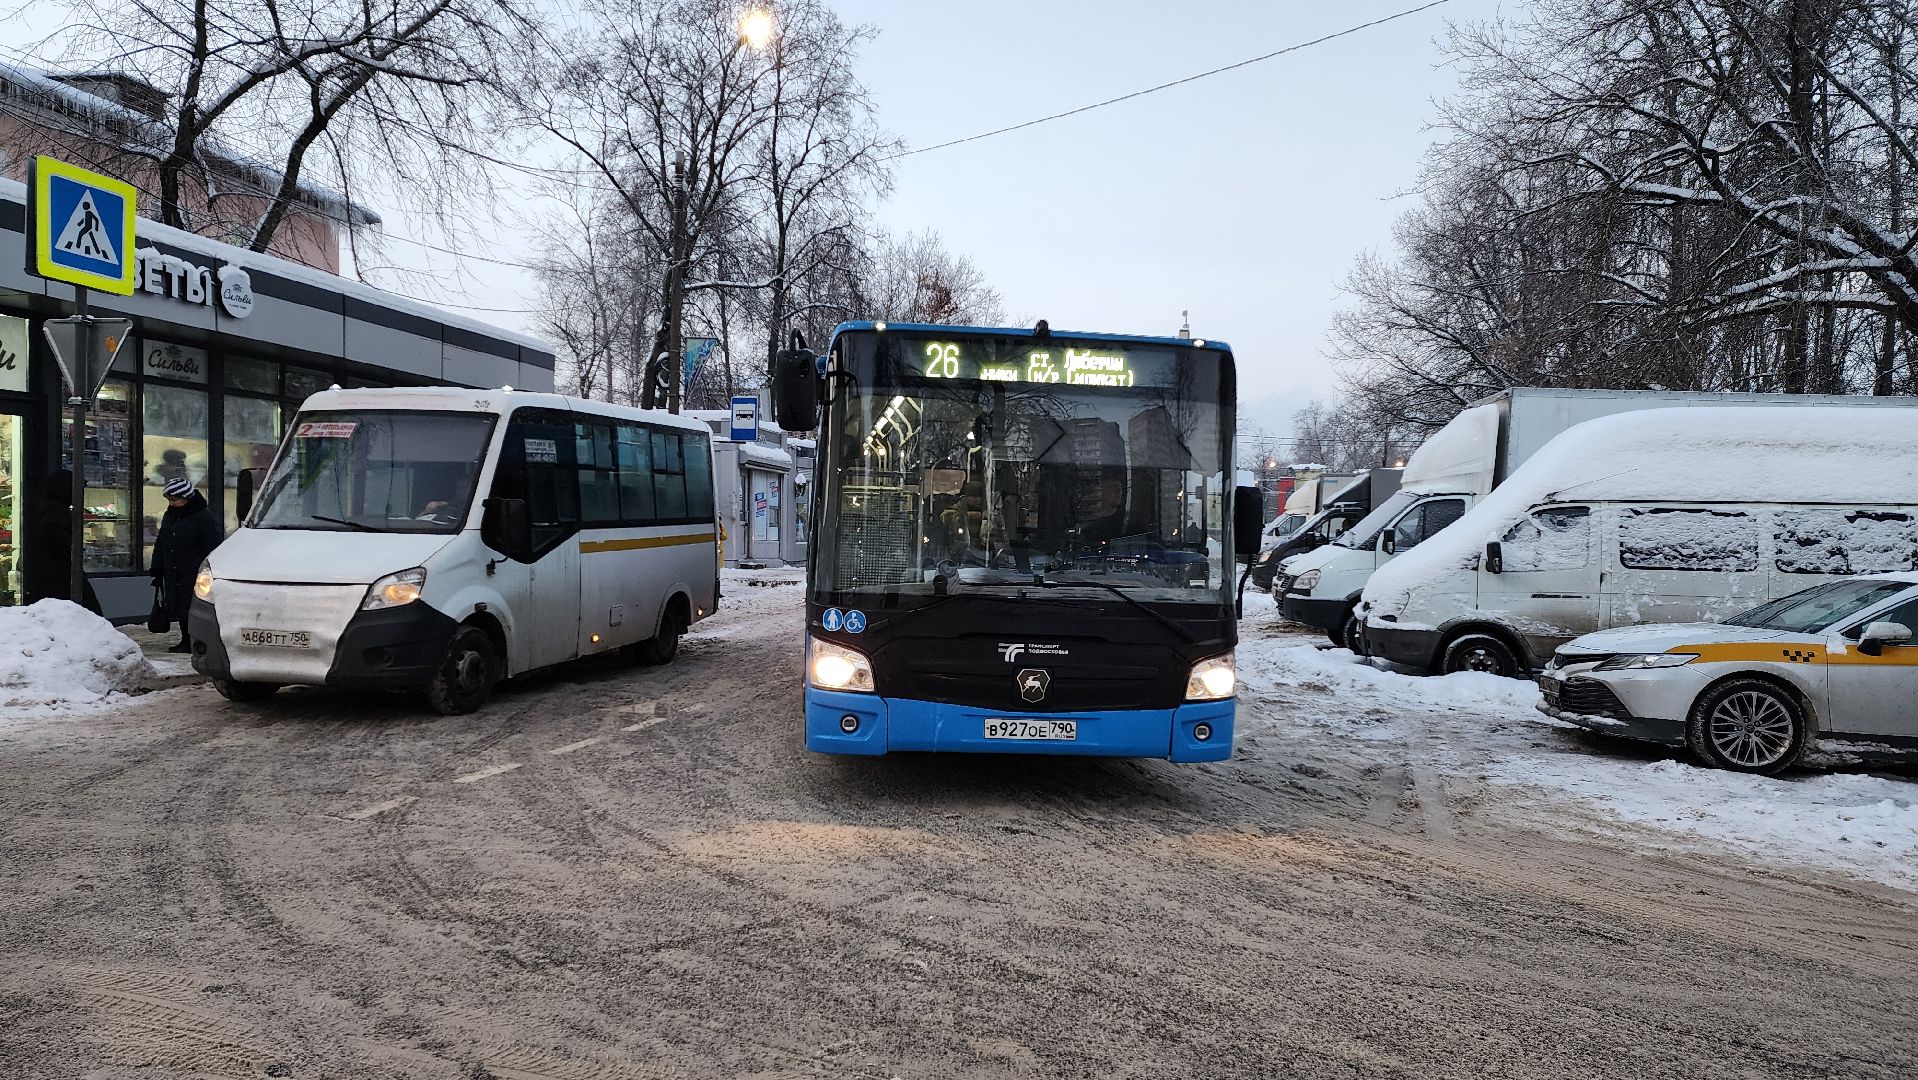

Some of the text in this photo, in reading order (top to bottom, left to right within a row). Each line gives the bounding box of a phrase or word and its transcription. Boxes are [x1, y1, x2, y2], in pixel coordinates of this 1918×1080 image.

[223, 288, 252, 305] Сильви
[148, 349, 200, 374] Сильви
[926, 343, 960, 378] 26
[298, 424, 313, 436] 2
[289, 632, 307, 643] 750
[989, 721, 1073, 738] В927ОЕ 790
